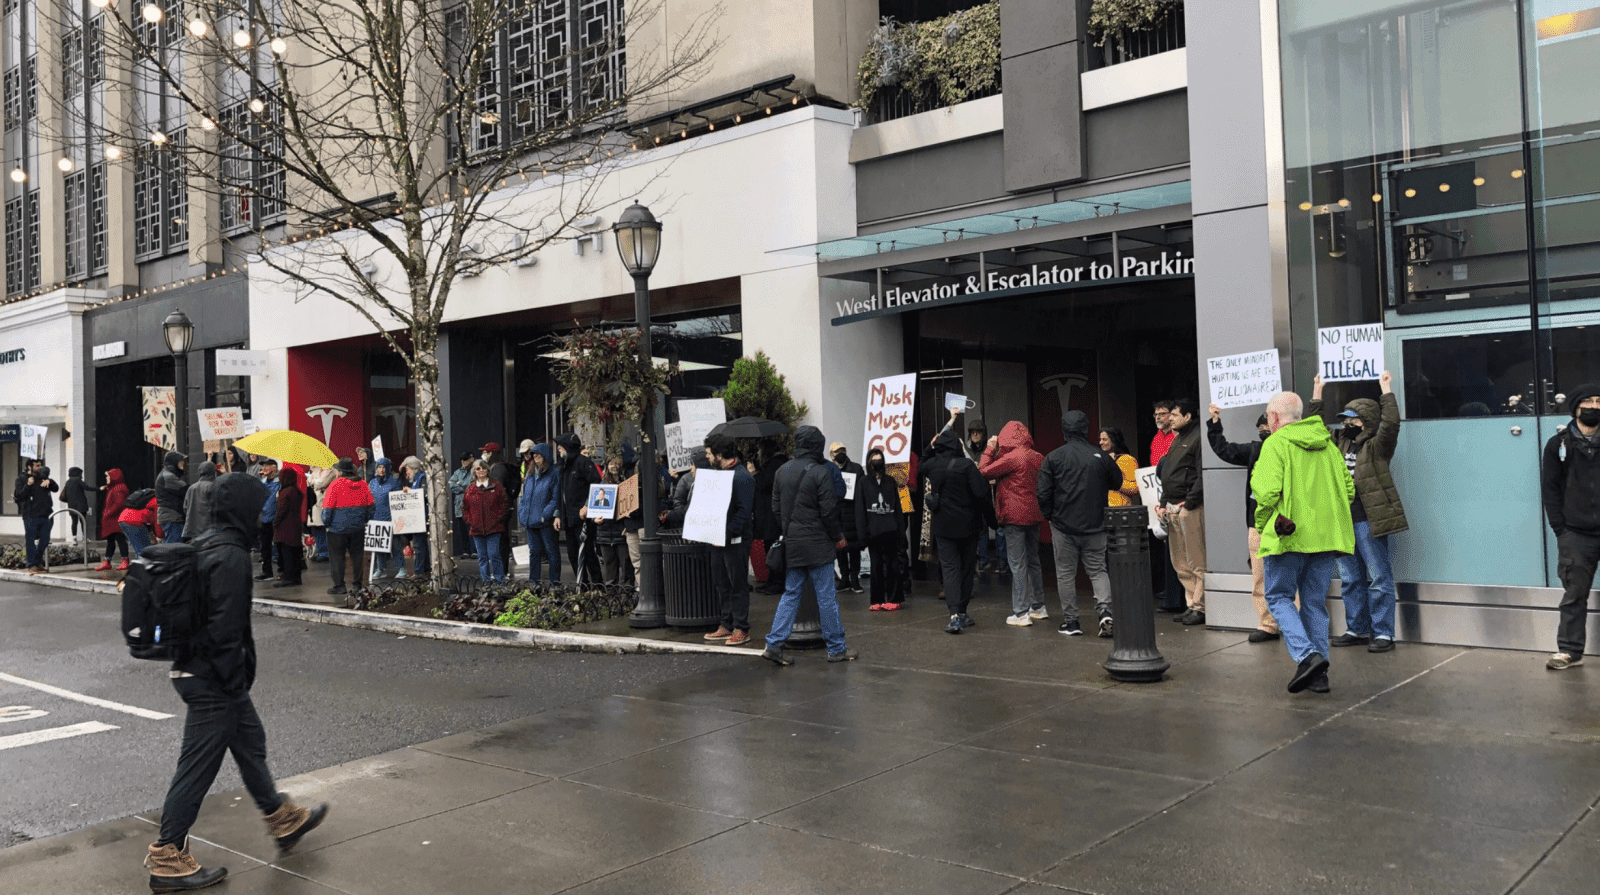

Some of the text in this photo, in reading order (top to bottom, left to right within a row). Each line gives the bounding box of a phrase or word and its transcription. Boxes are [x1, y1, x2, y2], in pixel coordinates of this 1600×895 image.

[836, 251, 1195, 317] West Elevator & Escalator to Parkin
[1321, 325, 1382, 345] NO HUMAN
[1209, 351, 1275, 370] THE ONLY MINORITY
[1342, 345, 1354, 360] IS
[1211, 365, 1277, 384] HURTING US ARE THE
[1323, 358, 1380, 379] ILLEGAL
[871, 383, 912, 407] Musk
[868, 411, 911, 431] Must
[868, 432, 908, 456] GO
